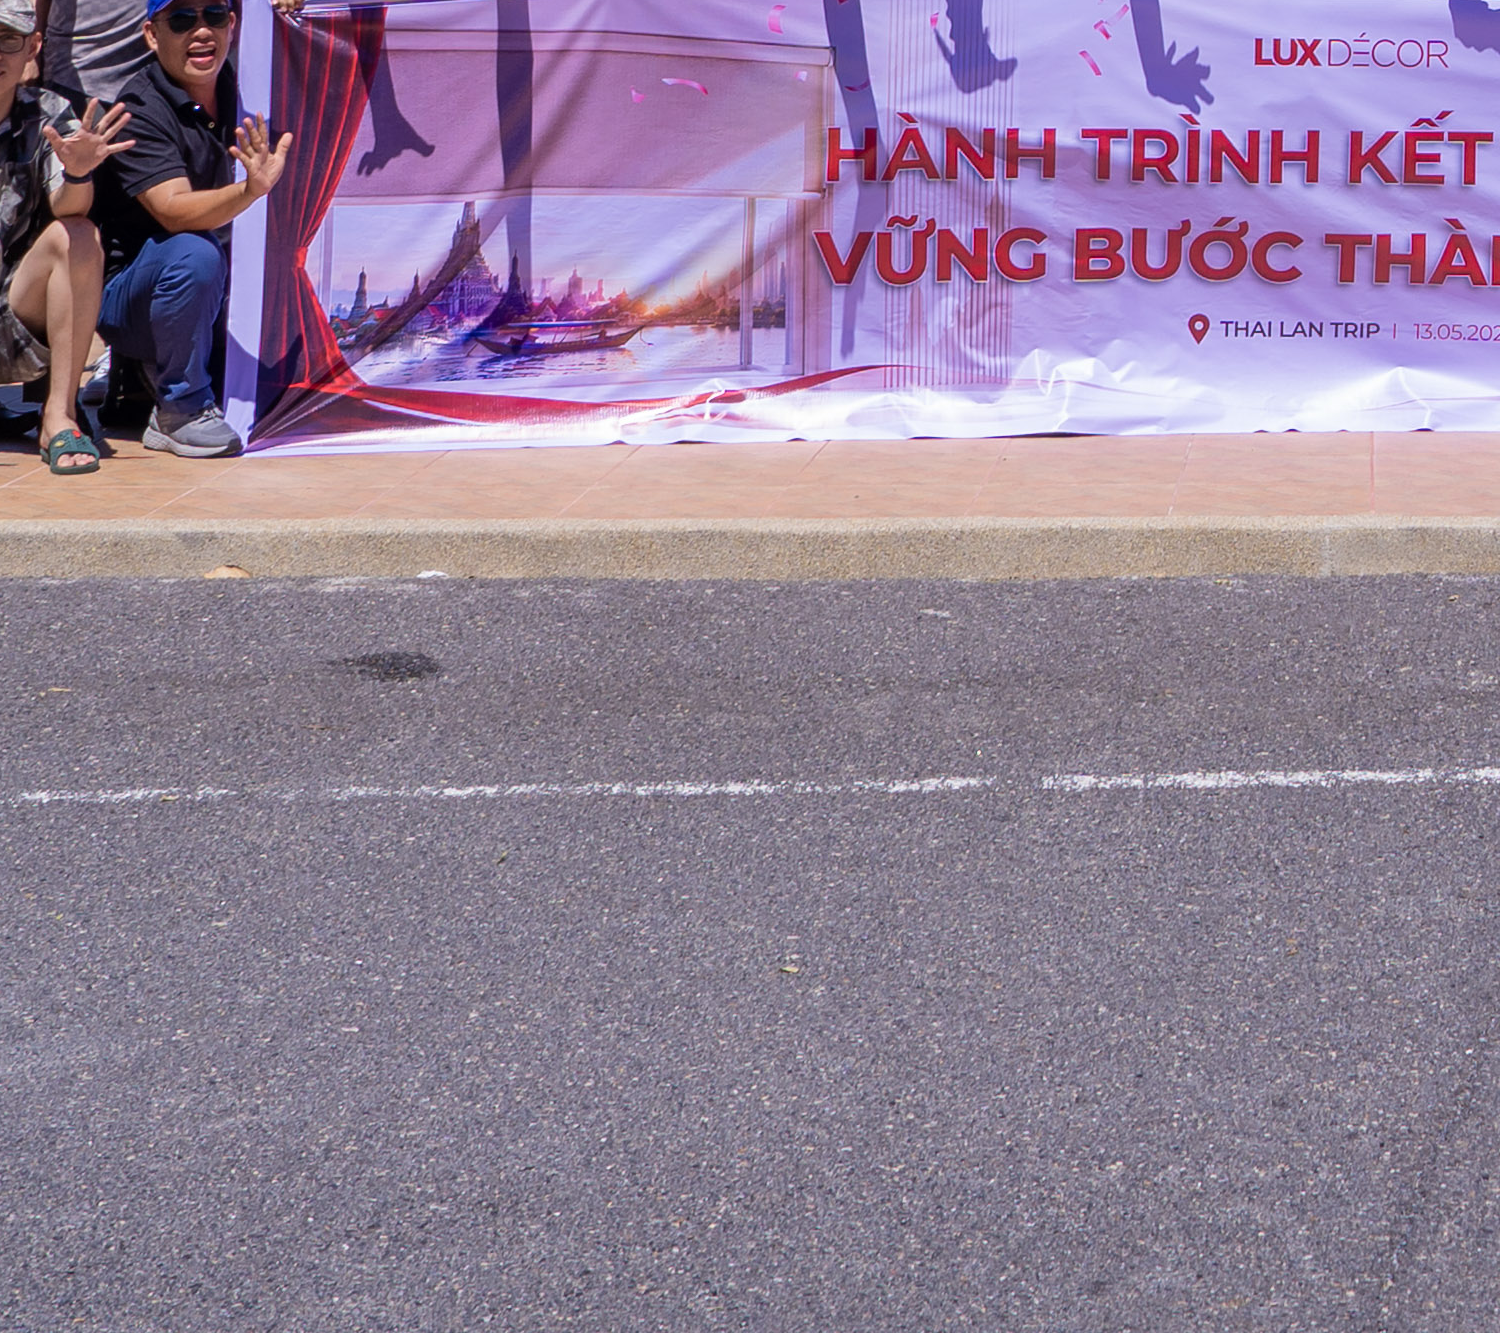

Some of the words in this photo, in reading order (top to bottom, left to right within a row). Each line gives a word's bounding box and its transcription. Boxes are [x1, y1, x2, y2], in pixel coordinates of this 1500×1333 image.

[825, 112, 1056, 183] HÀNH
[1080, 113, 1320, 185] TRÌNH
[1348, 110, 1494, 185] KẾT
[814, 214, 1048, 286] VỮNG
[1072, 216, 1304, 284] BƯỚC
[1220, 320, 1272, 338] THAI
[1279, 321, 1324, 338] LAN
[1329, 321, 1380, 339] TRIP
